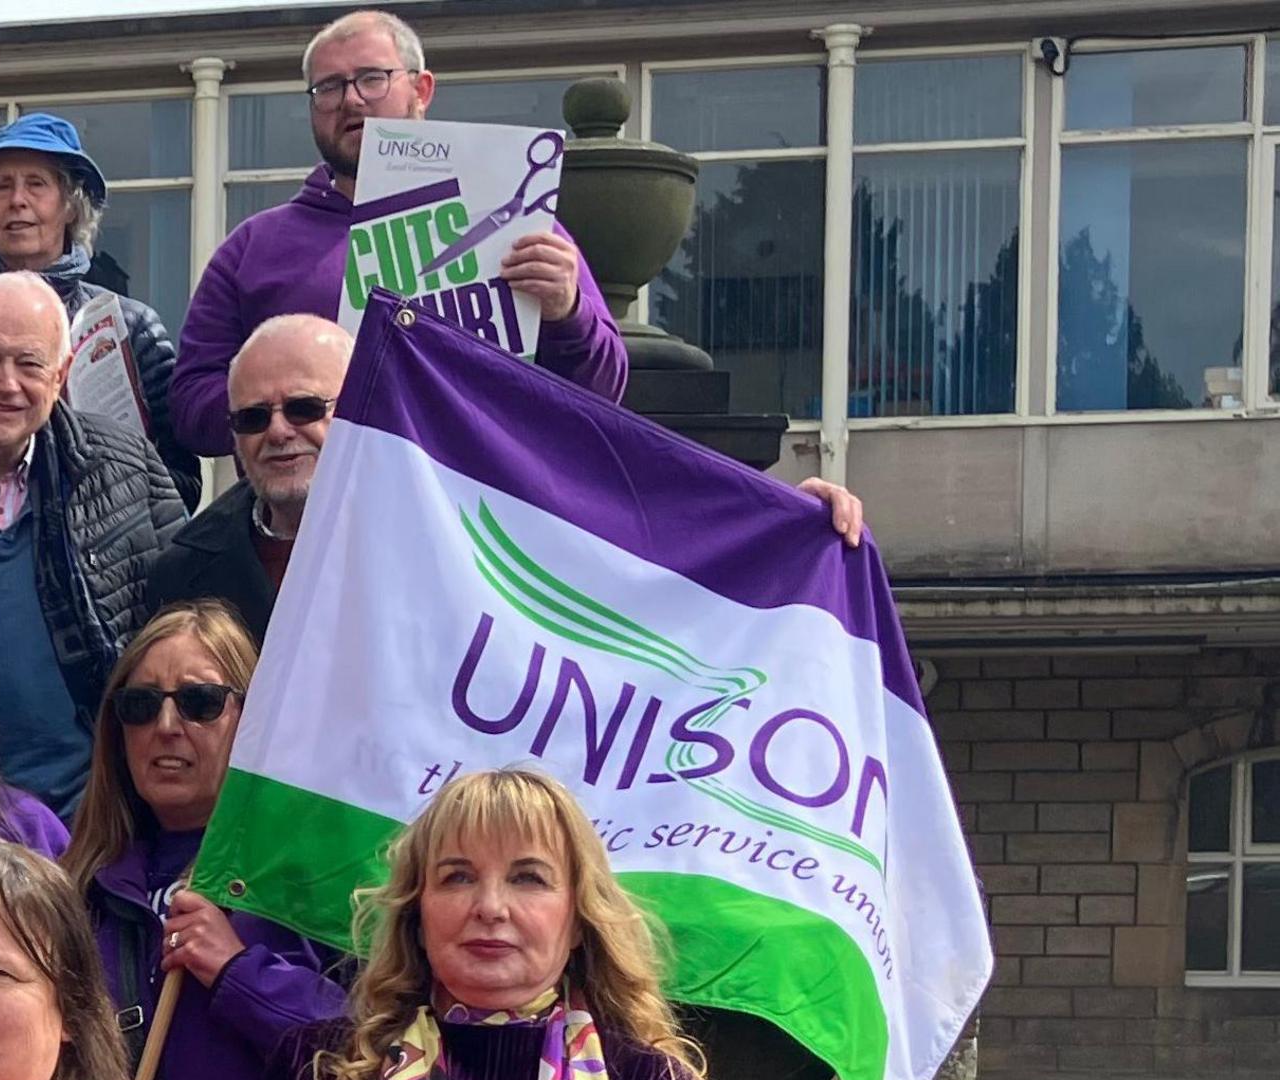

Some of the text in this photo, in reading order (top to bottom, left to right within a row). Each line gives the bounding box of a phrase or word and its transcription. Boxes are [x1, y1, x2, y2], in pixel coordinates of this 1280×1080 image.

[378, 140, 451, 161] UNISON
[345, 202, 478, 310] CUTS
[408, 277, 525, 353] URT
[644, 818, 819, 881] service
[831, 871, 895, 980] union
